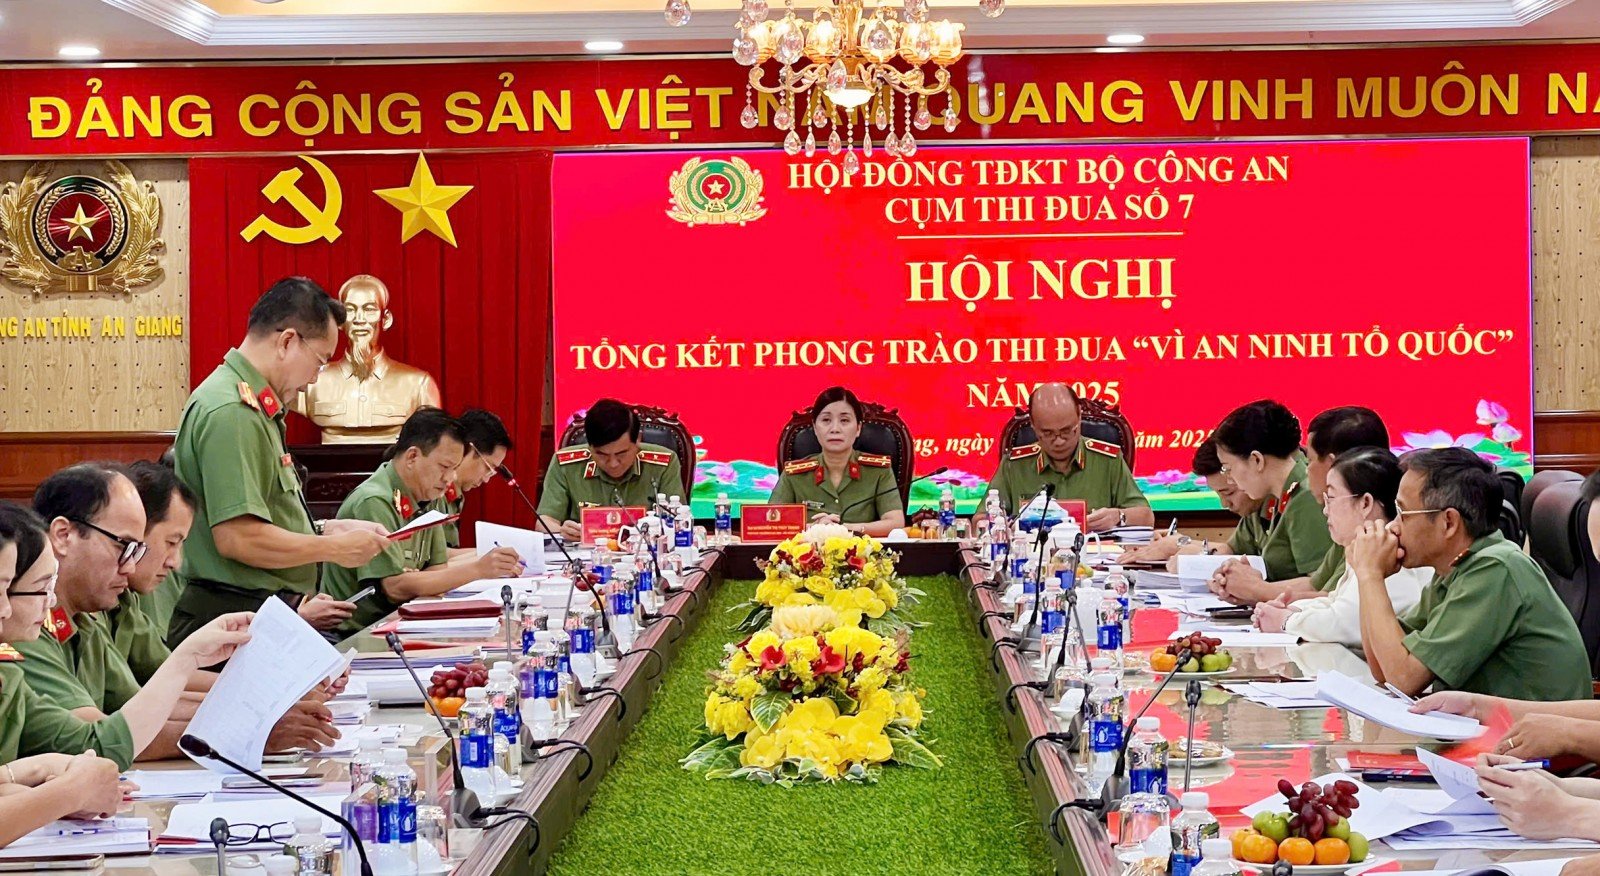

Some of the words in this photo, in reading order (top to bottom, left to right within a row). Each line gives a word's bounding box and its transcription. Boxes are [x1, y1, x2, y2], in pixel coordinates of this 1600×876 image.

[28, 77, 213, 139] ĐẢNG
[238, 80, 422, 146] CỘNG
[445, 72, 572, 133] SẢN
[595, 75, 733, 139] VIỆT
[917, 80, 1144, 127] QUANG
[1169, 78, 1313, 120] VINH
[1337, 60, 1519, 118] MUÔN
[1548, 71, 1600, 115] N
[788, 158, 853, 194] HỘI
[862, 155, 964, 187] ĐỒNG
[972, 160, 1067, 186] TĐKT
[1077, 155, 1124, 190] BỘ
[1134, 150, 1234, 184] CÔNG
[1242, 156, 1289, 182] AN
[885, 198, 964, 230] CỤM
[974, 197, 1034, 222] THI
[1045, 194, 1117, 221] ĐUA
[1125, 188, 1169, 220] SỐ
[1178, 194, 1194, 218] 7
[906, 255, 1013, 312] HỘI
[1028, 258, 1176, 310] NGHỊ
[0, 317, 18, 338] NG
[24, 317, 46, 338] AN
[51, 309, 92, 338] TỈNH
[101, 315, 125, 337] AN
[135, 315, 182, 337] GIANG
[570, 337, 666, 369] TỔNG
[676, 336, 745, 367] KẾT
[754, 340, 874, 367] PHONG
[883, 332, 978, 364] TRÀO
[986, 338, 1045, 362] THI
[1055, 337, 1125, 362] ĐUA
[1134, 329, 1185, 360] “VÌ
[1193, 334, 1238, 360] AN
[1249, 332, 1333, 359] NINH
[1342, 325, 1388, 357] TỔ
[1398, 324, 1513, 361] QUỐC”
[1072, 381, 1119, 406] 025
[913, 438, 939, 457] ng,
[945, 433, 994, 456] ngày
[1135, 431, 1163, 448] ăm
[1169, 429, 1214, 448] 202
